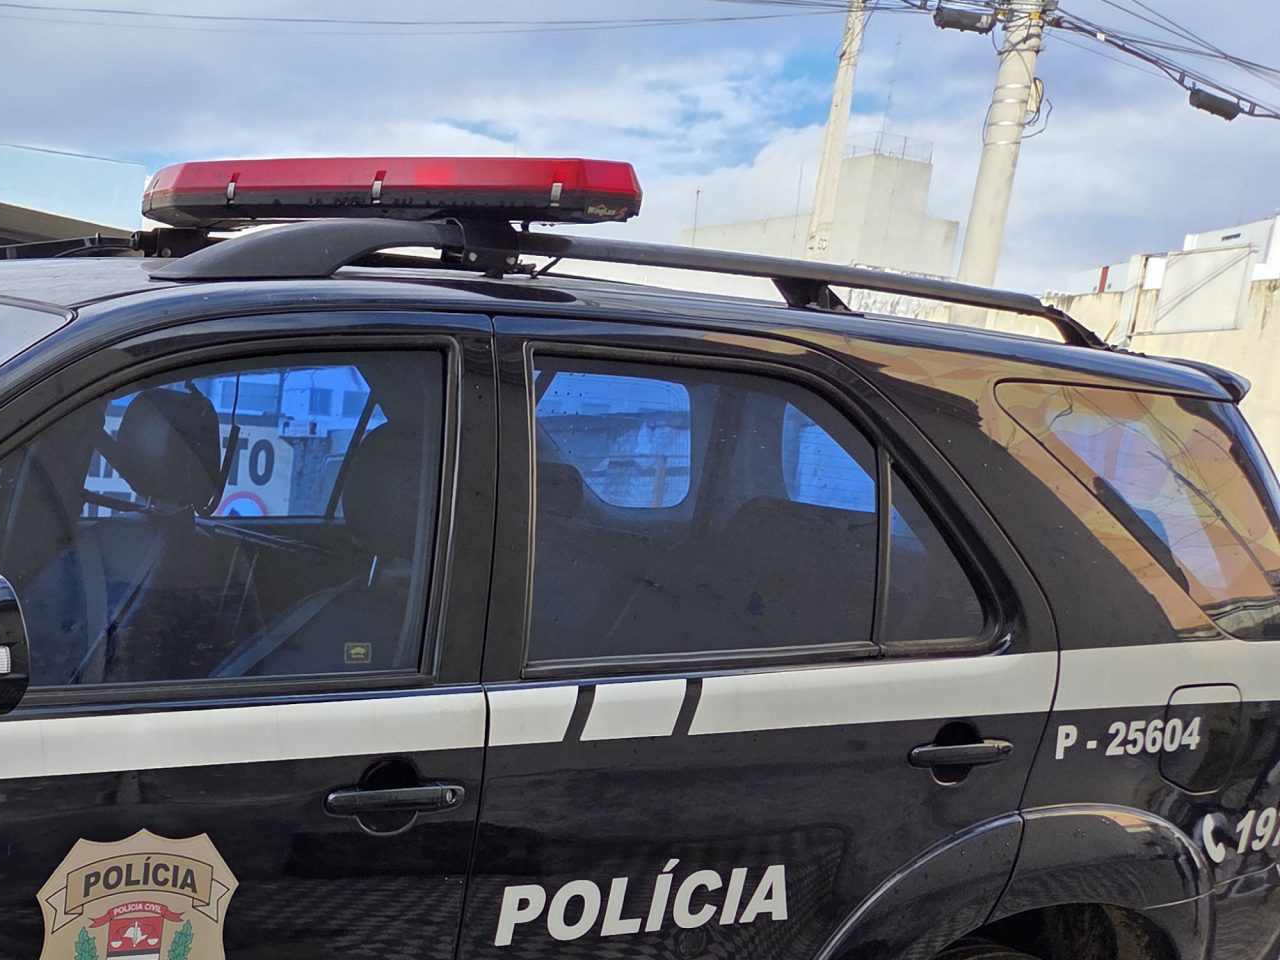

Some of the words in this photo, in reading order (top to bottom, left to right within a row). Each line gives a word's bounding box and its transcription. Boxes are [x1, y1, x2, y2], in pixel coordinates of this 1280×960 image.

[1055, 725, 1077, 759] P
[1105, 717, 1201, 756] 25604
[83, 857, 198, 898] POLÍCIA
[144, 903, 162, 913] CIVIL
[493, 858, 788, 947] POLÍCIA
